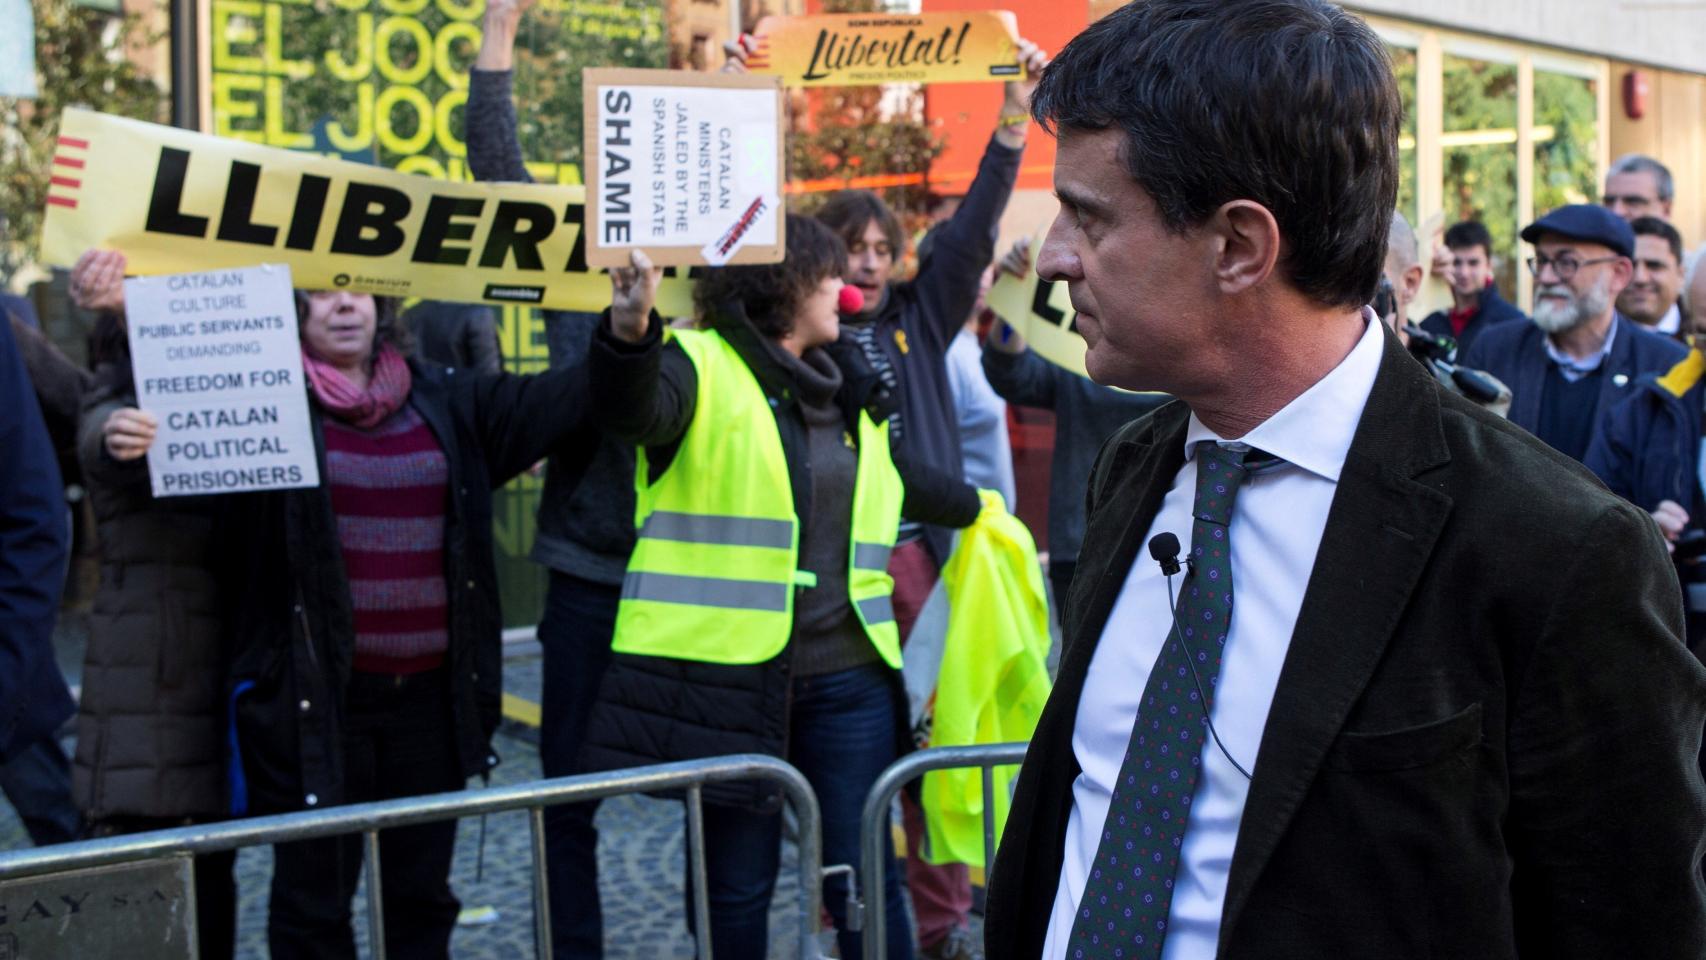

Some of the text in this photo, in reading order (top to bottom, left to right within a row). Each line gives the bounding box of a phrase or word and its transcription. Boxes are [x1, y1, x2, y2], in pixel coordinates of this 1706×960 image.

[802, 22, 971, 81] Llibertat!
[605, 89, 632, 243] SHAME
[652, 98, 665, 237] SPANISH STATE
[675, 102, 688, 233] JAILED BY THE
[699, 122, 710, 215] MINISTERS
[719, 128, 731, 210] CATALAN
[167, 272, 244, 291] CATALAN
[168, 294, 247, 313] CULTURE
[138, 316, 284, 339] PUBLIC SERVANTS
[166, 341, 262, 361] DEMANDING
[144, 369, 291, 395] FREEDOM FOR
[167, 405, 279, 431] CATALAN
[167, 436, 289, 461] POLITICAL
